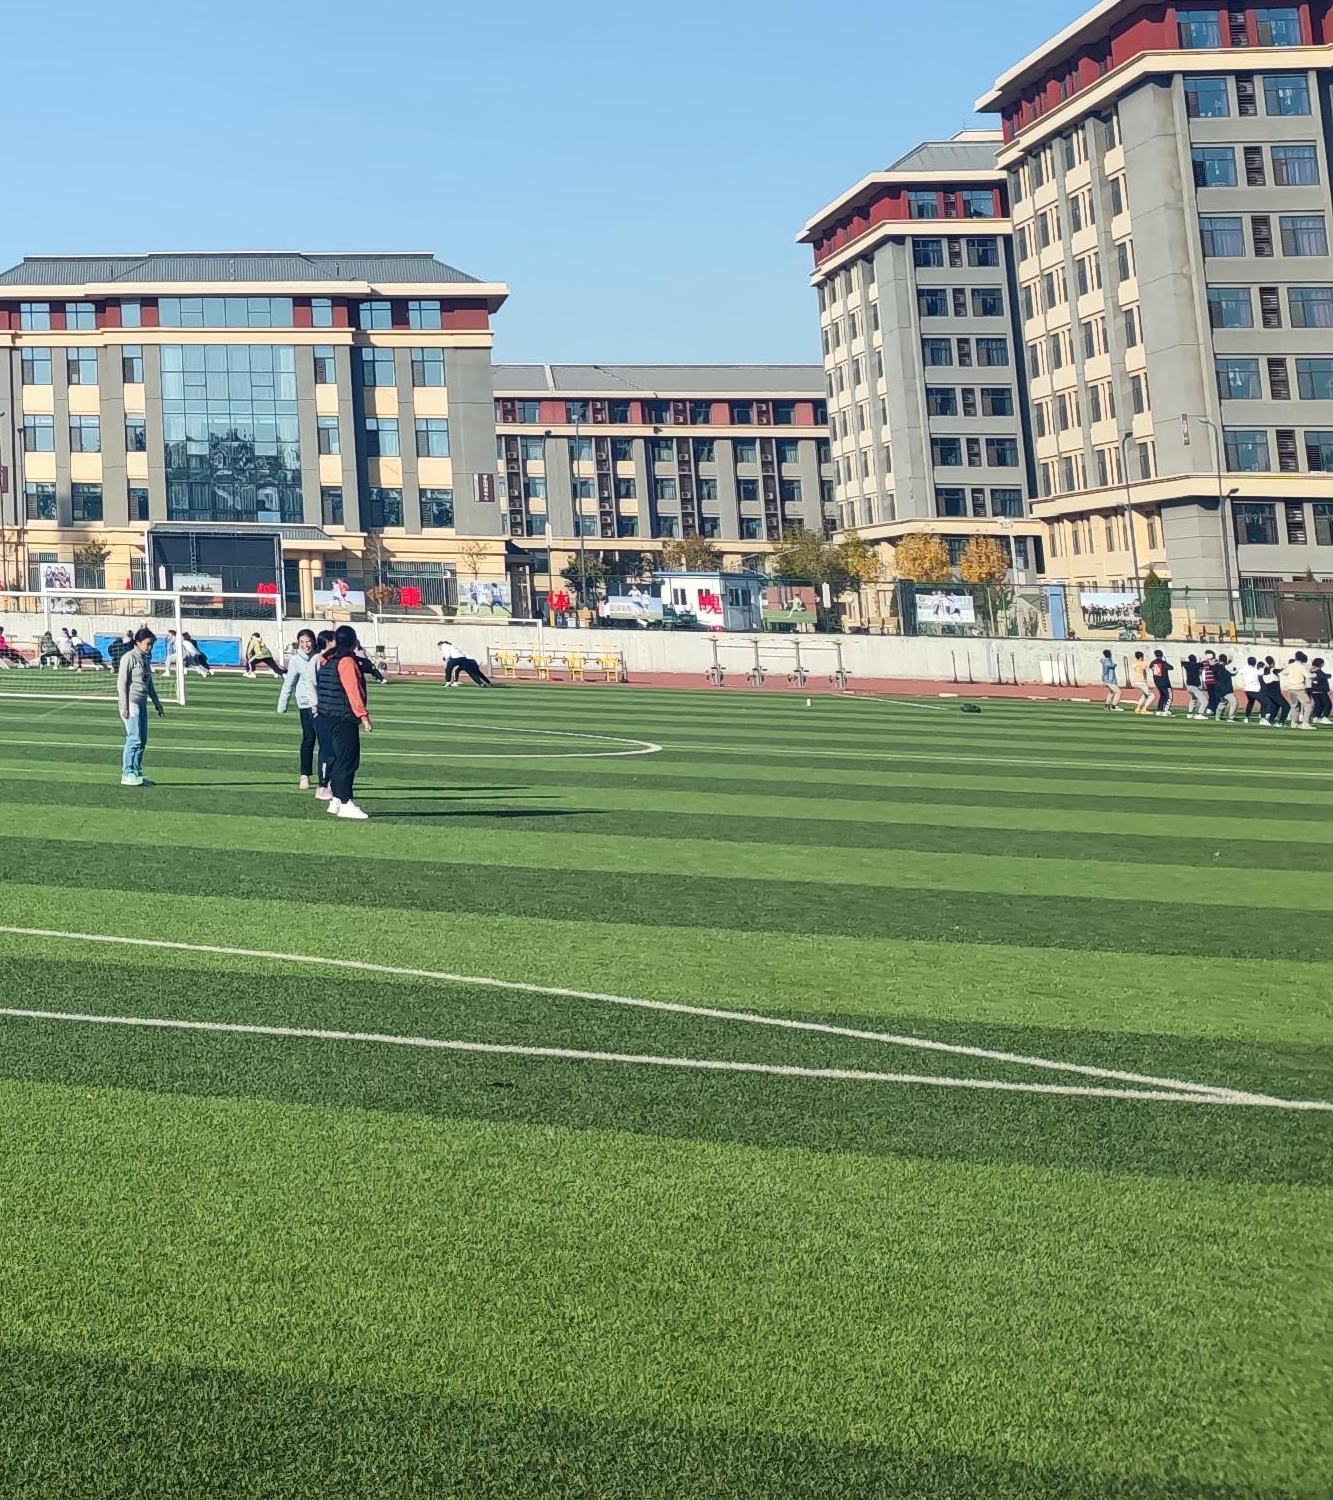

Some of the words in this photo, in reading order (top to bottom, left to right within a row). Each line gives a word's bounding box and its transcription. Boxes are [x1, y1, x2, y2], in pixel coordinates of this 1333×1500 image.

[399, 586, 422, 609] 康
[546, 590, 571, 612] 体
[698, 593, 722, 614] 魄
